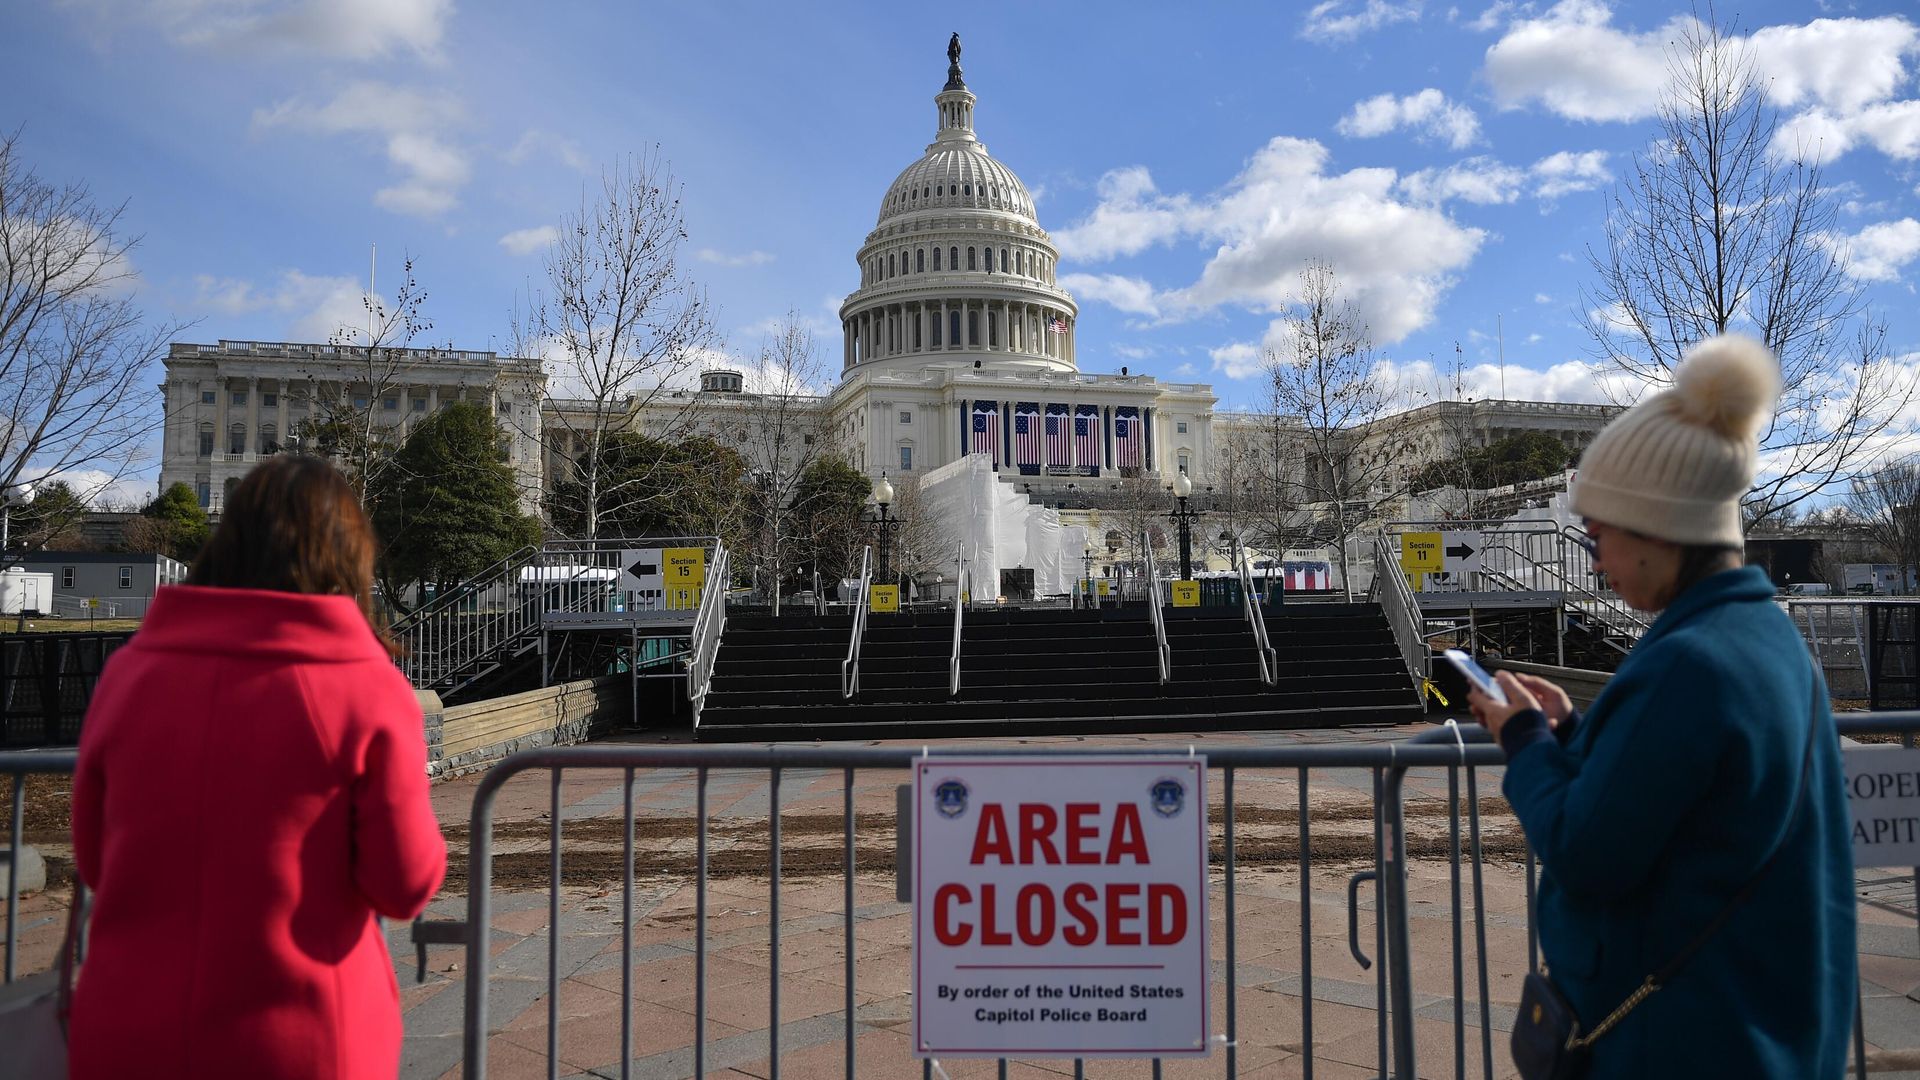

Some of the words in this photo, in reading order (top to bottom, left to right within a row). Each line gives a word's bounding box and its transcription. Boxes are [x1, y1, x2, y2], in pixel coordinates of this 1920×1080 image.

[1409, 541, 1435, 549] Section
[1417, 550, 1427, 560] 11
[678, 566, 690, 576] 15
[678, 590, 688, 599] 15
[1182, 592, 1191, 600] 13
[880, 596, 889, 604] 13
[1845, 772, 1920, 799] OPE
[969, 803, 1151, 865] AREA
[933, 882, 1188, 947] CLOSED
[937, 984, 959, 1000] By
[964, 984, 1009, 999] order
[1014, 984, 1031, 999] of
[1036, 984, 1063, 999] the
[1069, 984, 1124, 999] United
[1130, 984, 1184, 999] States
[974, 1007, 1034, 1023] Capitol
[1040, 1007, 1092, 1022] Police
[1097, 1007, 1147, 1022] Board
